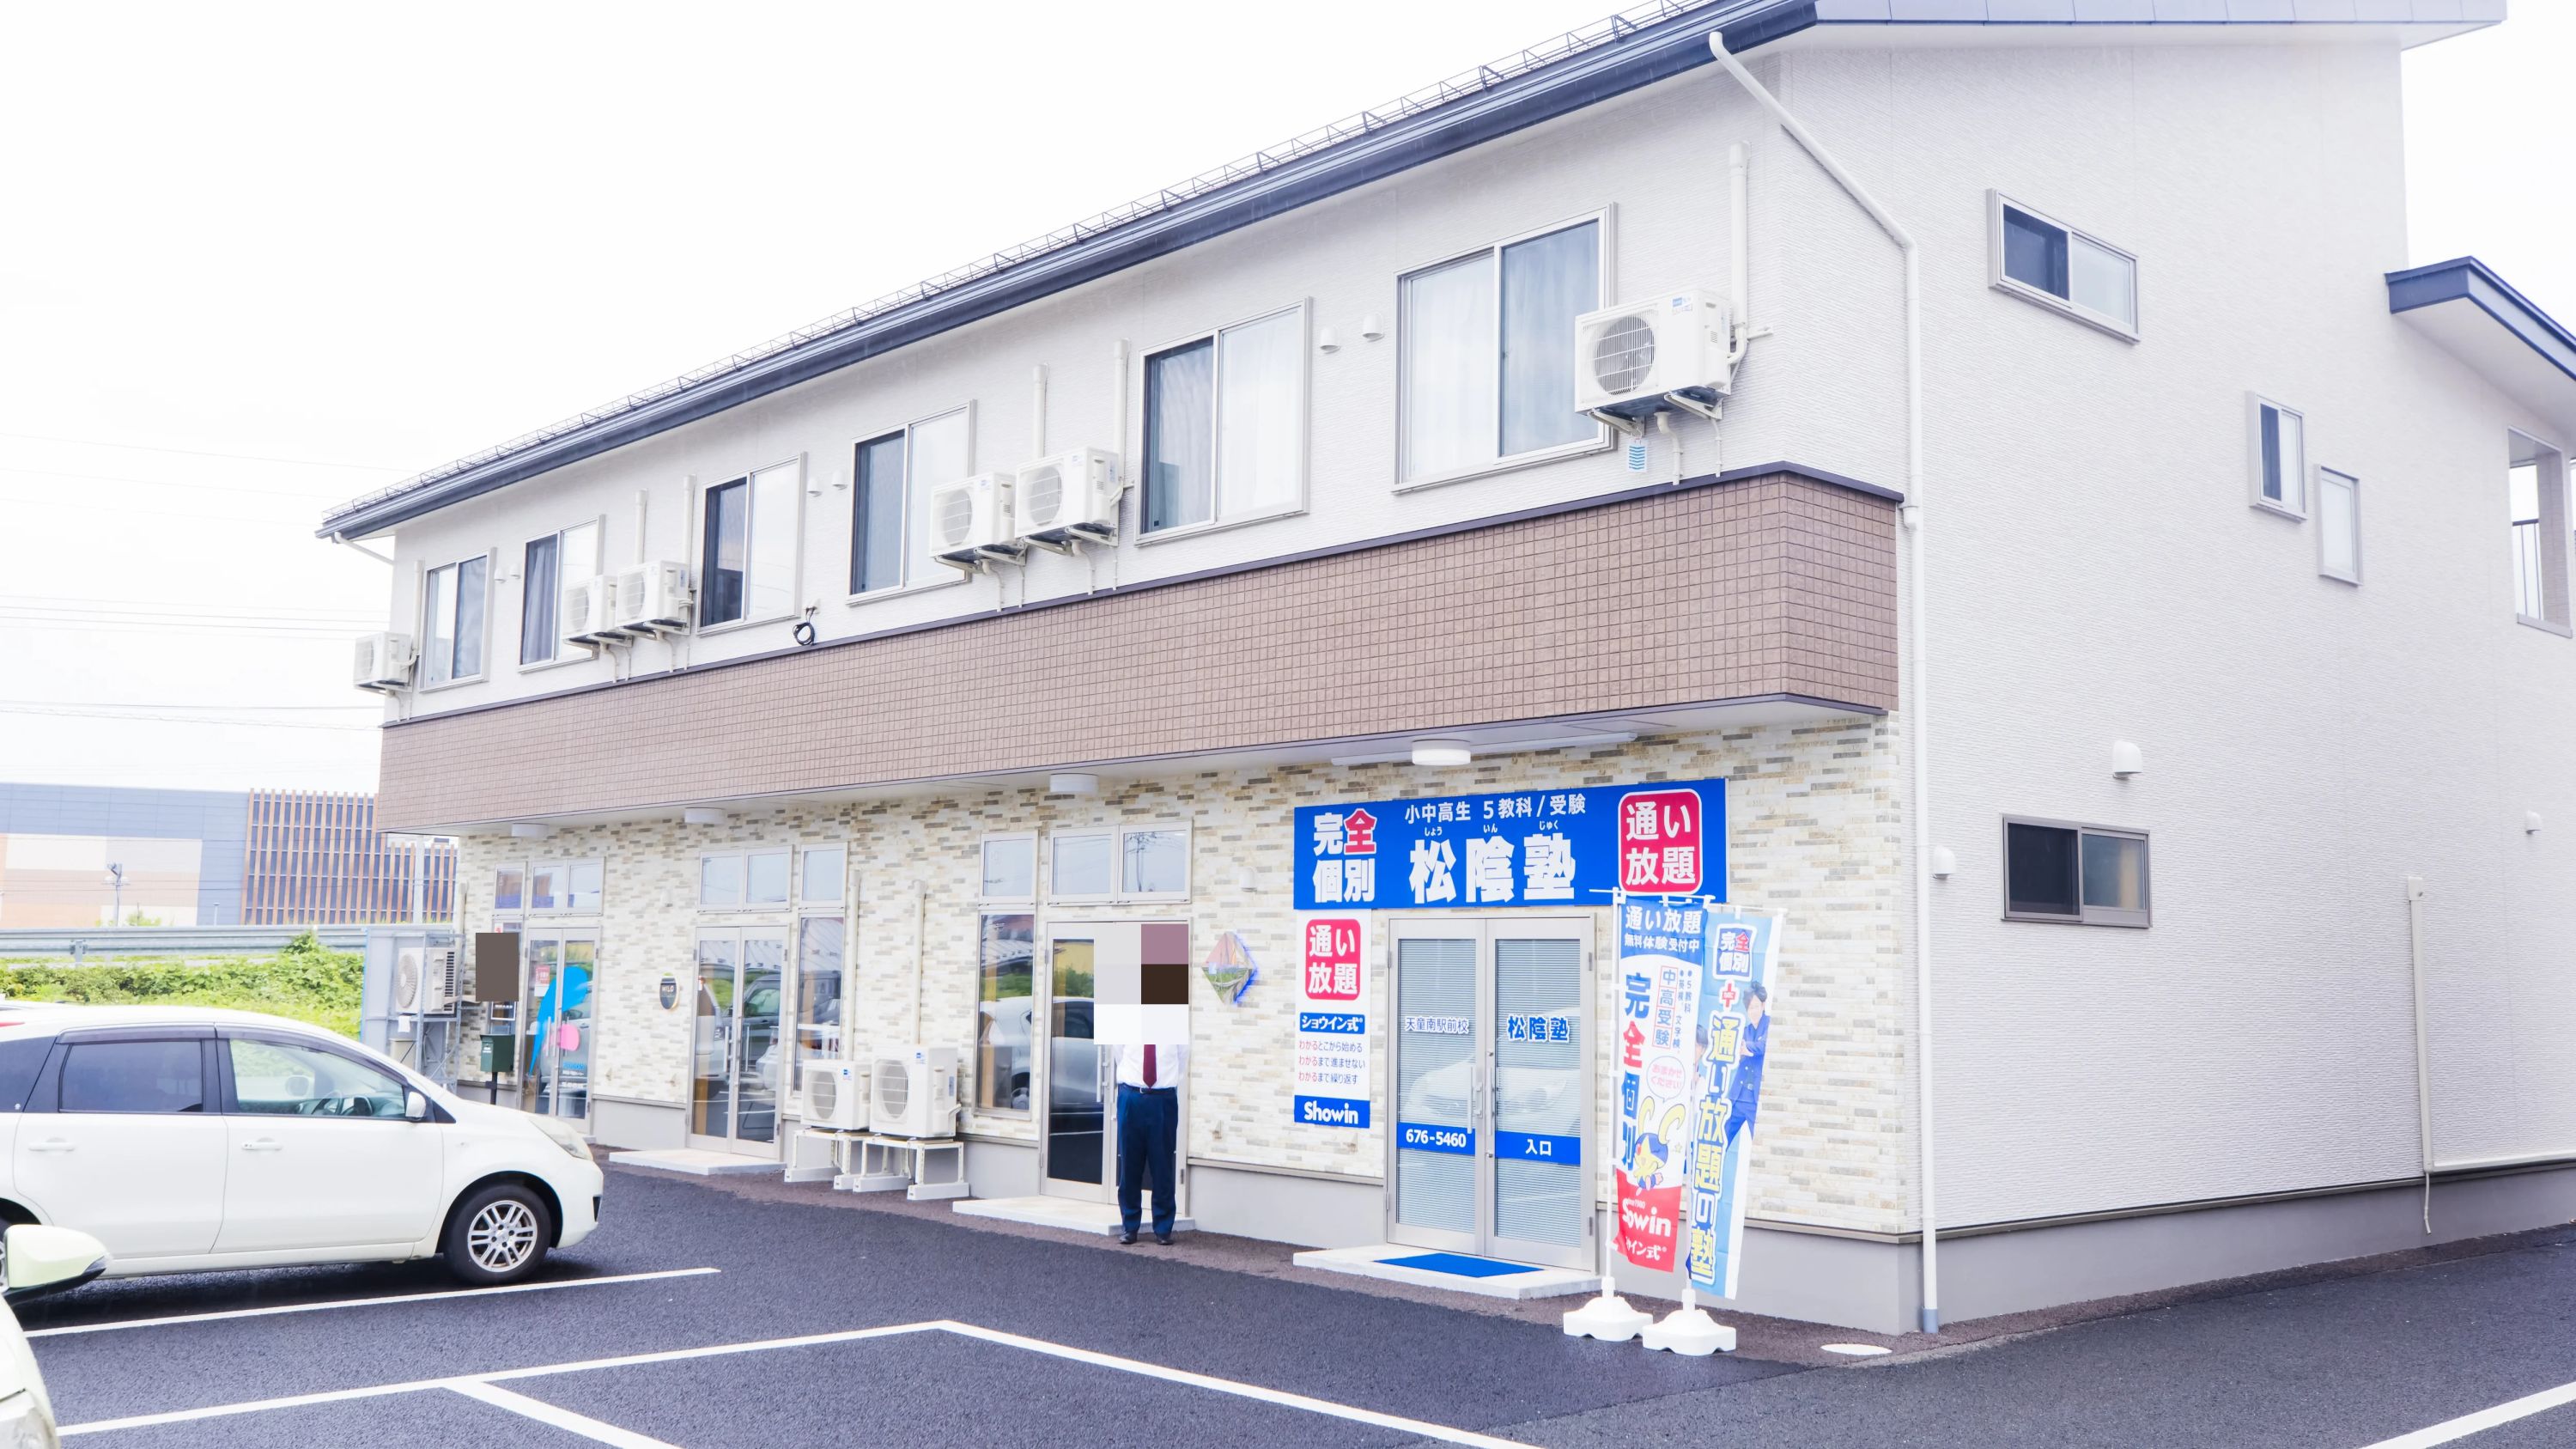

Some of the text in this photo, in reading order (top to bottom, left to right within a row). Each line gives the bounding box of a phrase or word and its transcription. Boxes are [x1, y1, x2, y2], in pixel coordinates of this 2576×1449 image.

[1405, 801, 1471, 825] 小中高生
[1625, 801, 1692, 841] 通い
[1313, 808, 1377, 856] 完全
[1408, 832, 1577, 904] 松陰塾
[1625, 846, 1696, 886] 放題
[1312, 858, 1376, 904] 個別
[1625, 905, 1703, 934] 通い放題
[1309, 924, 1356, 957] 通い
[1624, 933, 1700, 953] 無料体験受付中
[1721, 931, 1749, 952] 完全
[1308, 961, 1358, 994] 放題
[1655, 969, 1676, 1046] 中高受験
[1406, 1016, 1469, 1032] 天童南駅前校
[1507, 1015, 1570, 1042] 松陰塾
[1303, 1099, 1358, 1124] Showin
[1406, 1129, 1467, 1148] 676-5460
[1525, 1138, 1552, 1156] 入口
